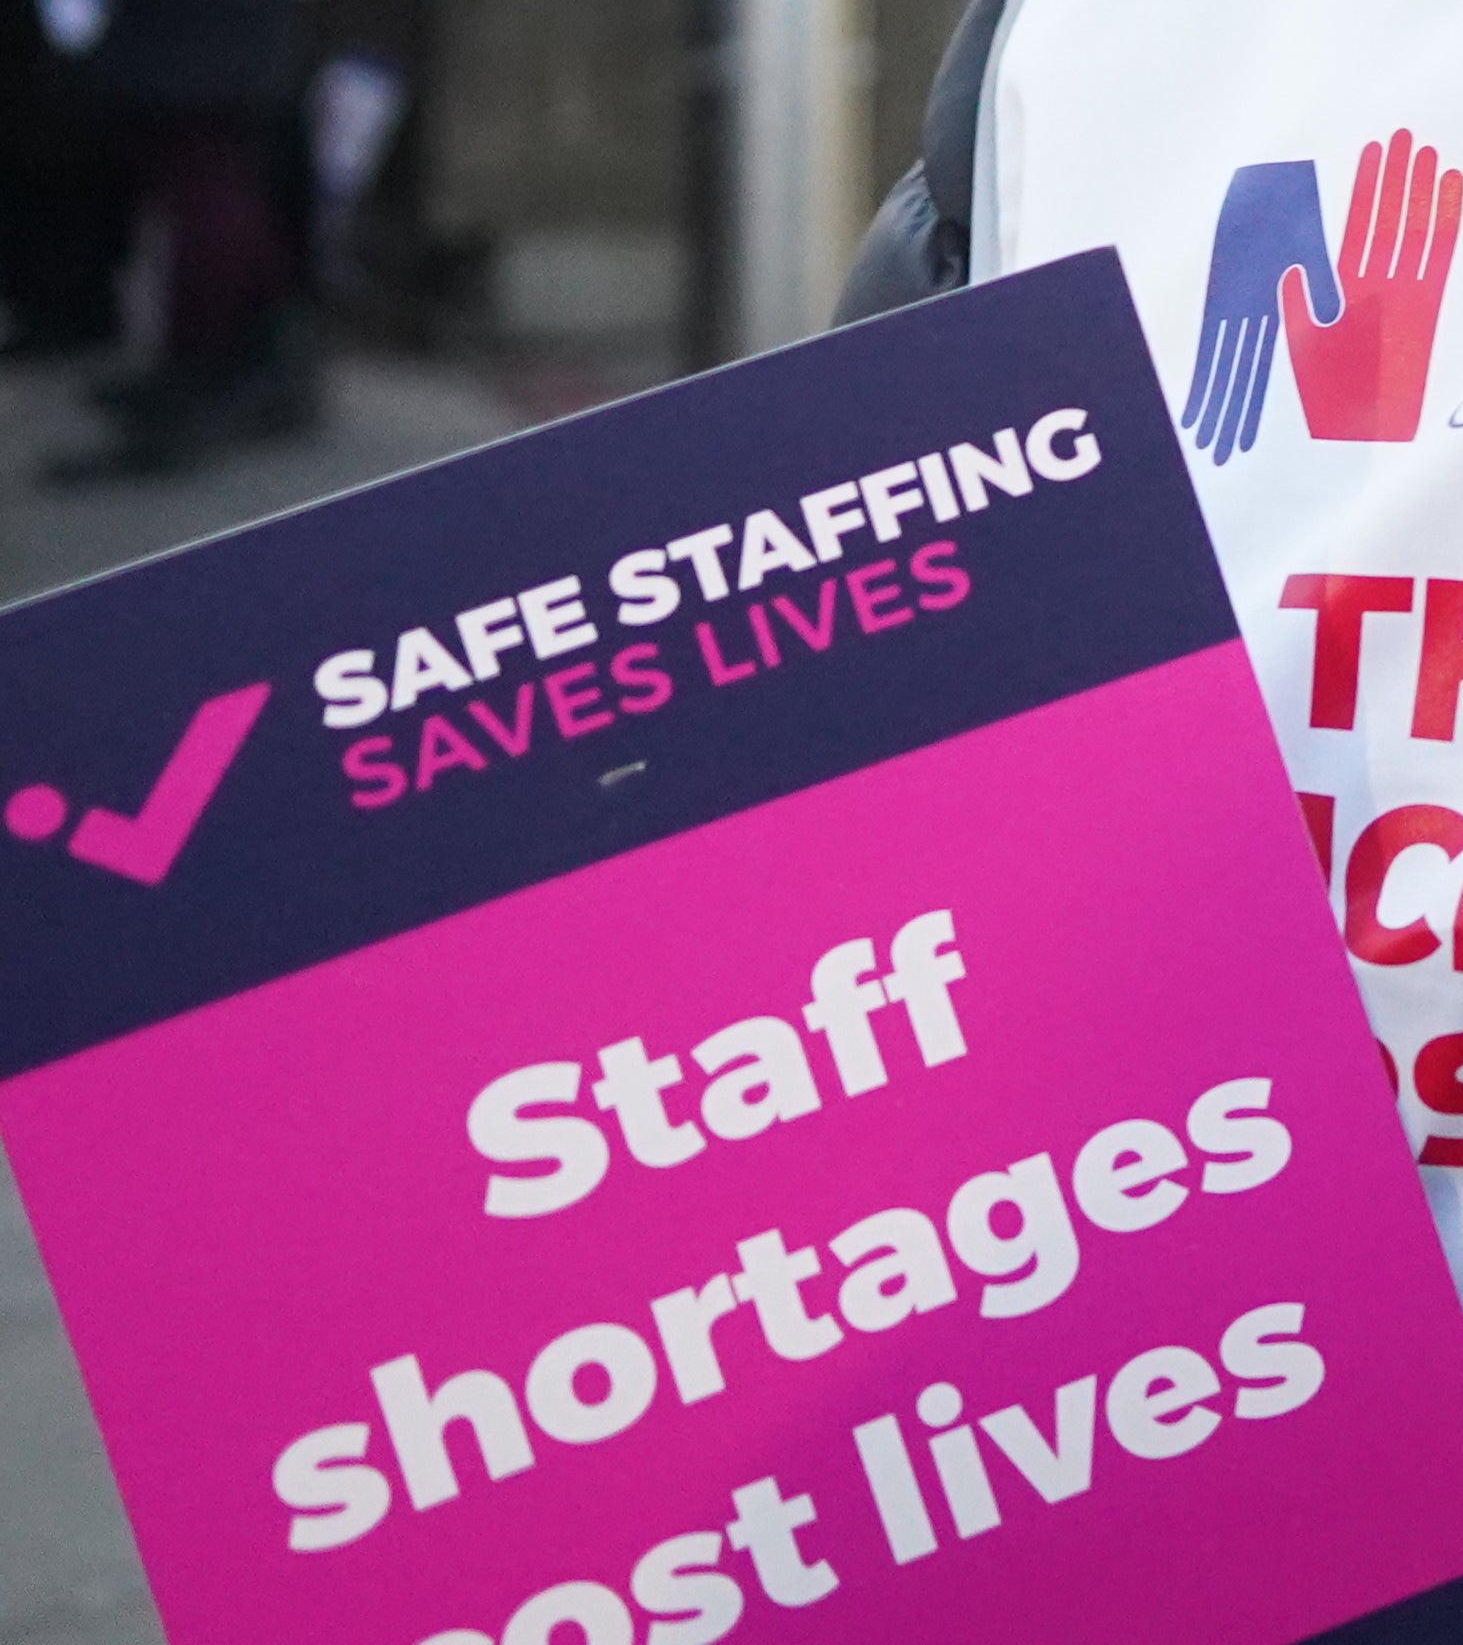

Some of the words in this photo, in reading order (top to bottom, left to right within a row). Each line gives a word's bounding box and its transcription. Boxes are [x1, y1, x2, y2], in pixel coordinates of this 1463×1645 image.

[312, 573, 599, 729] SAFE
[606, 406, 1102, 627] STAFFING
[339, 642, 675, 811] SAVES
[694, 539, 973, 687] LIVES
[464, 908, 971, 1219] Staff
[270, 1075, 1292, 1553] shortages
[410, 1475, 840, 1645] ost
[852, 1300, 1326, 1566] lives
